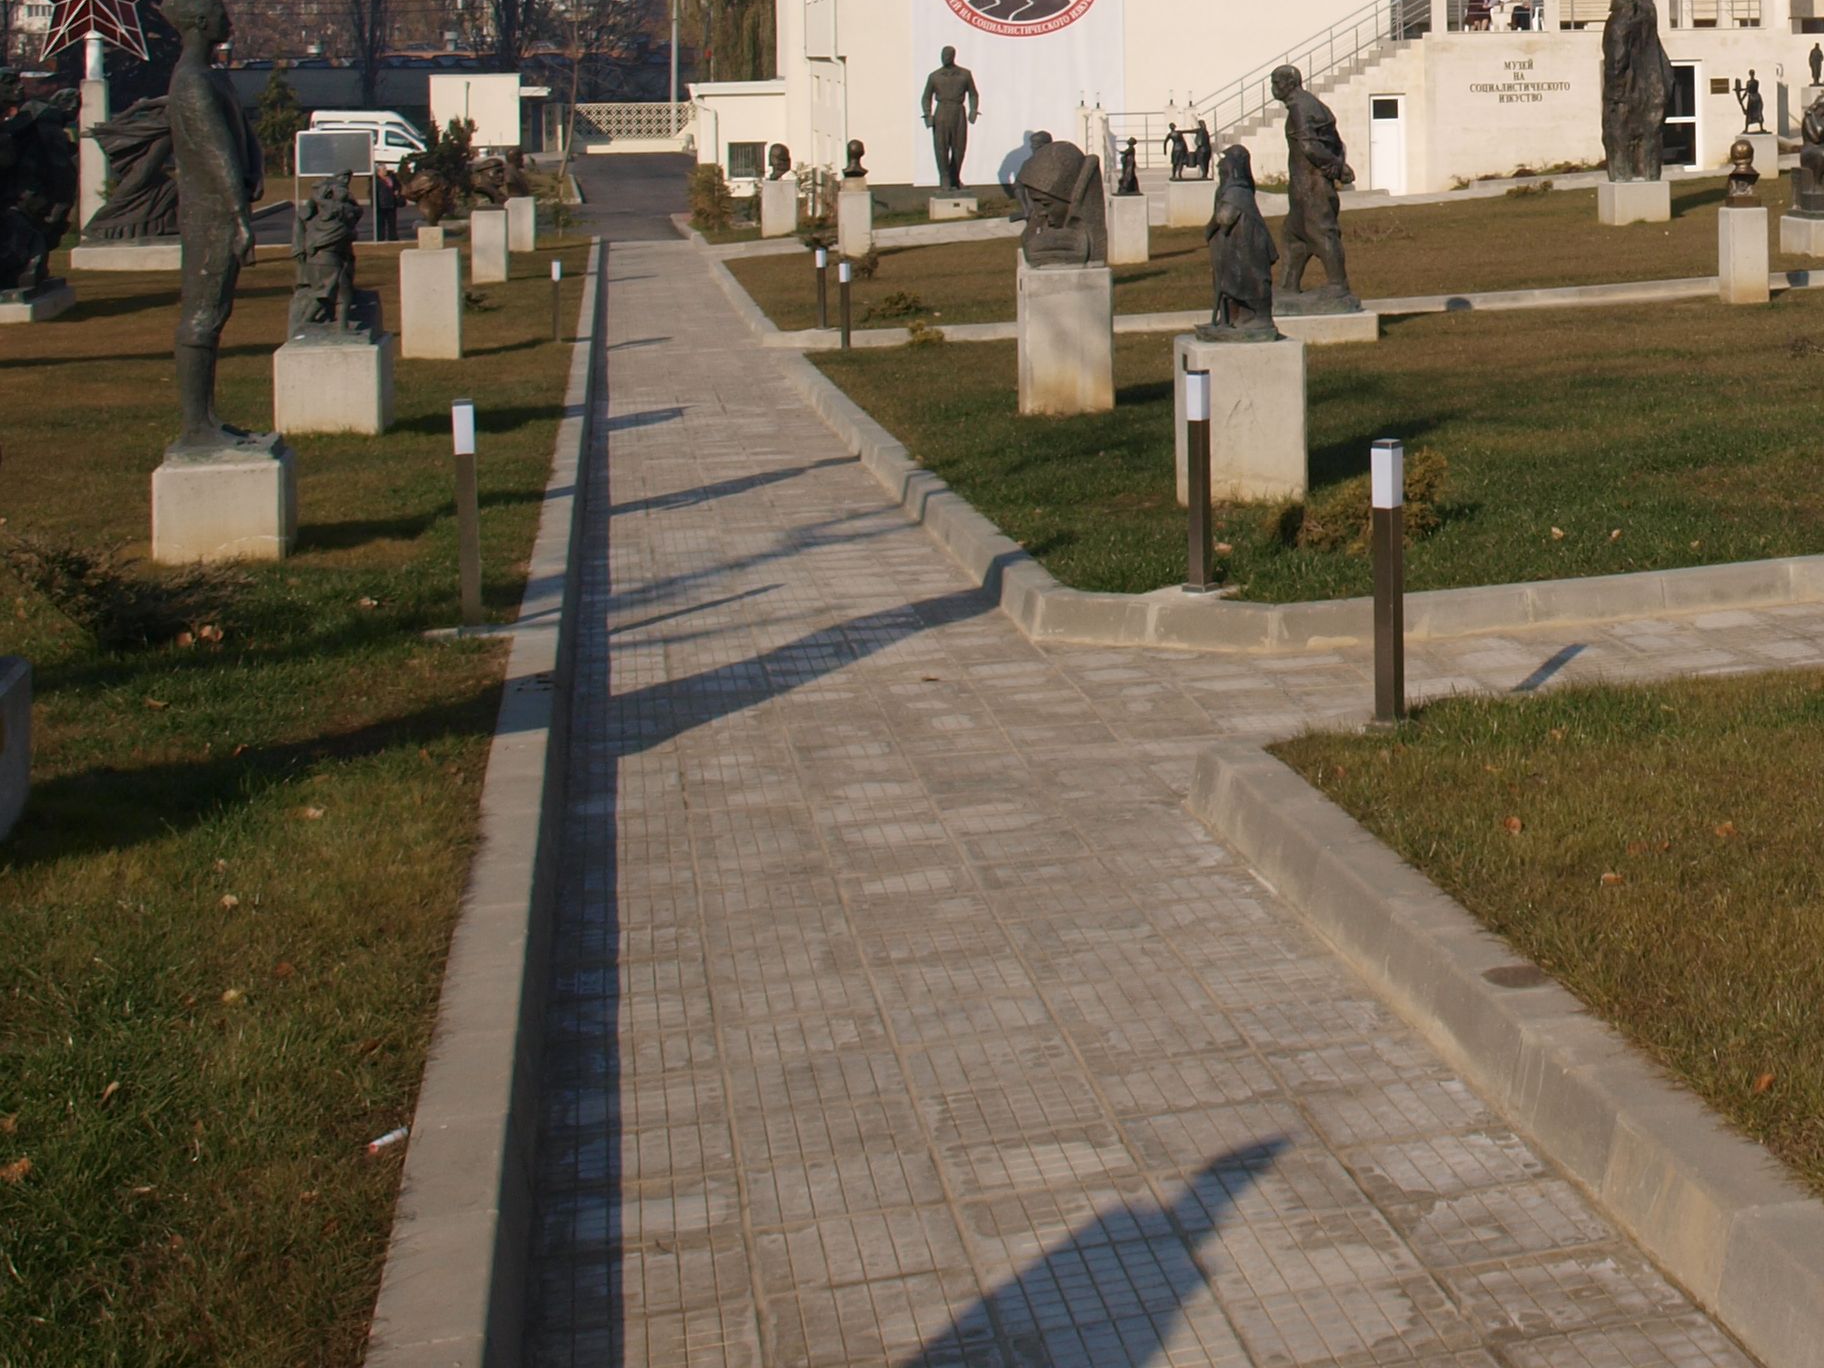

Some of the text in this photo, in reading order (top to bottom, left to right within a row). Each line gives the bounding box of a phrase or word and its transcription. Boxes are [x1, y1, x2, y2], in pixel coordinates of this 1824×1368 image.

[959, 6, 972, 21] НА
[1504, 59, 1533, 70] МУЗЕЙ
[1513, 72, 1525, 81] НА
[1469, 82, 1571, 92] СОЦИАЛИСТИЧЕСКОТО
[1499, 93, 1543, 103] ИЗКУСТВО
